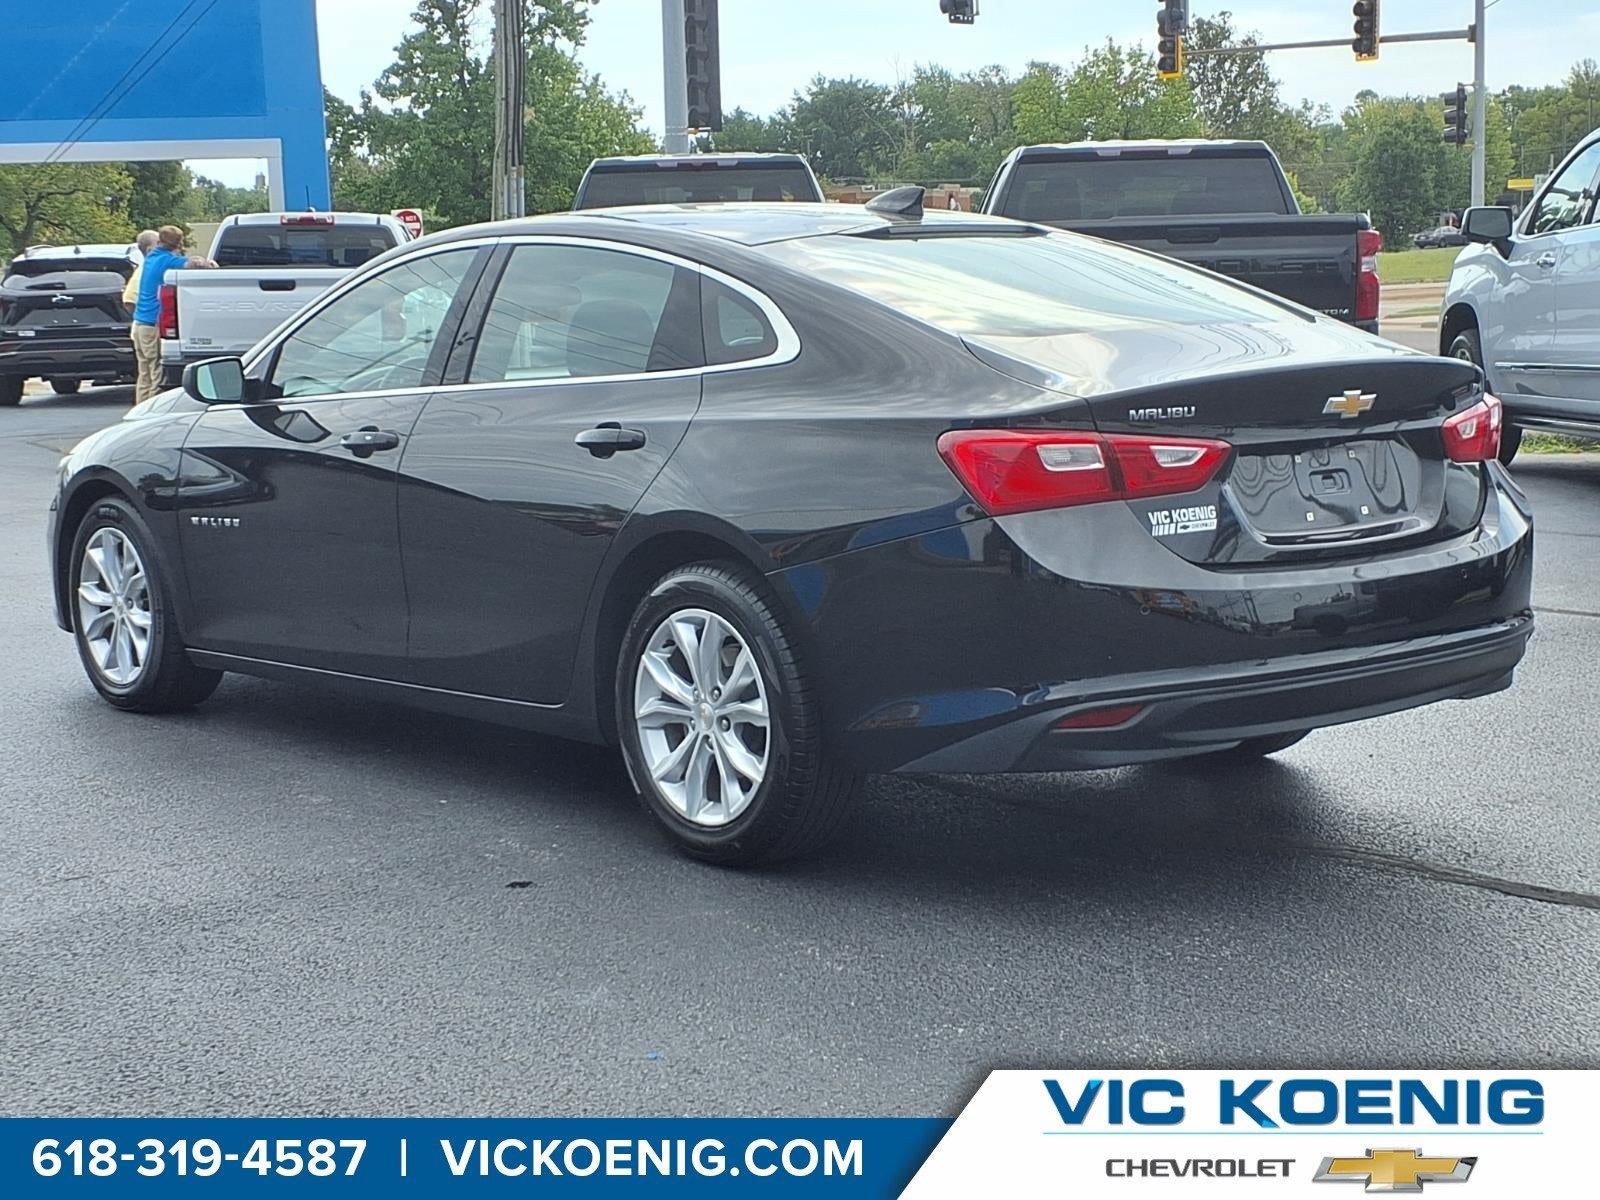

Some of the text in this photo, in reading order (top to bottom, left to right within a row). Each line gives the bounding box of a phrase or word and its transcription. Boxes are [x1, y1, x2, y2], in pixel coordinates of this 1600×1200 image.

[1128, 406, 1196, 421] MALIBU
[1148, 505, 1217, 526] VIC KOENIG
